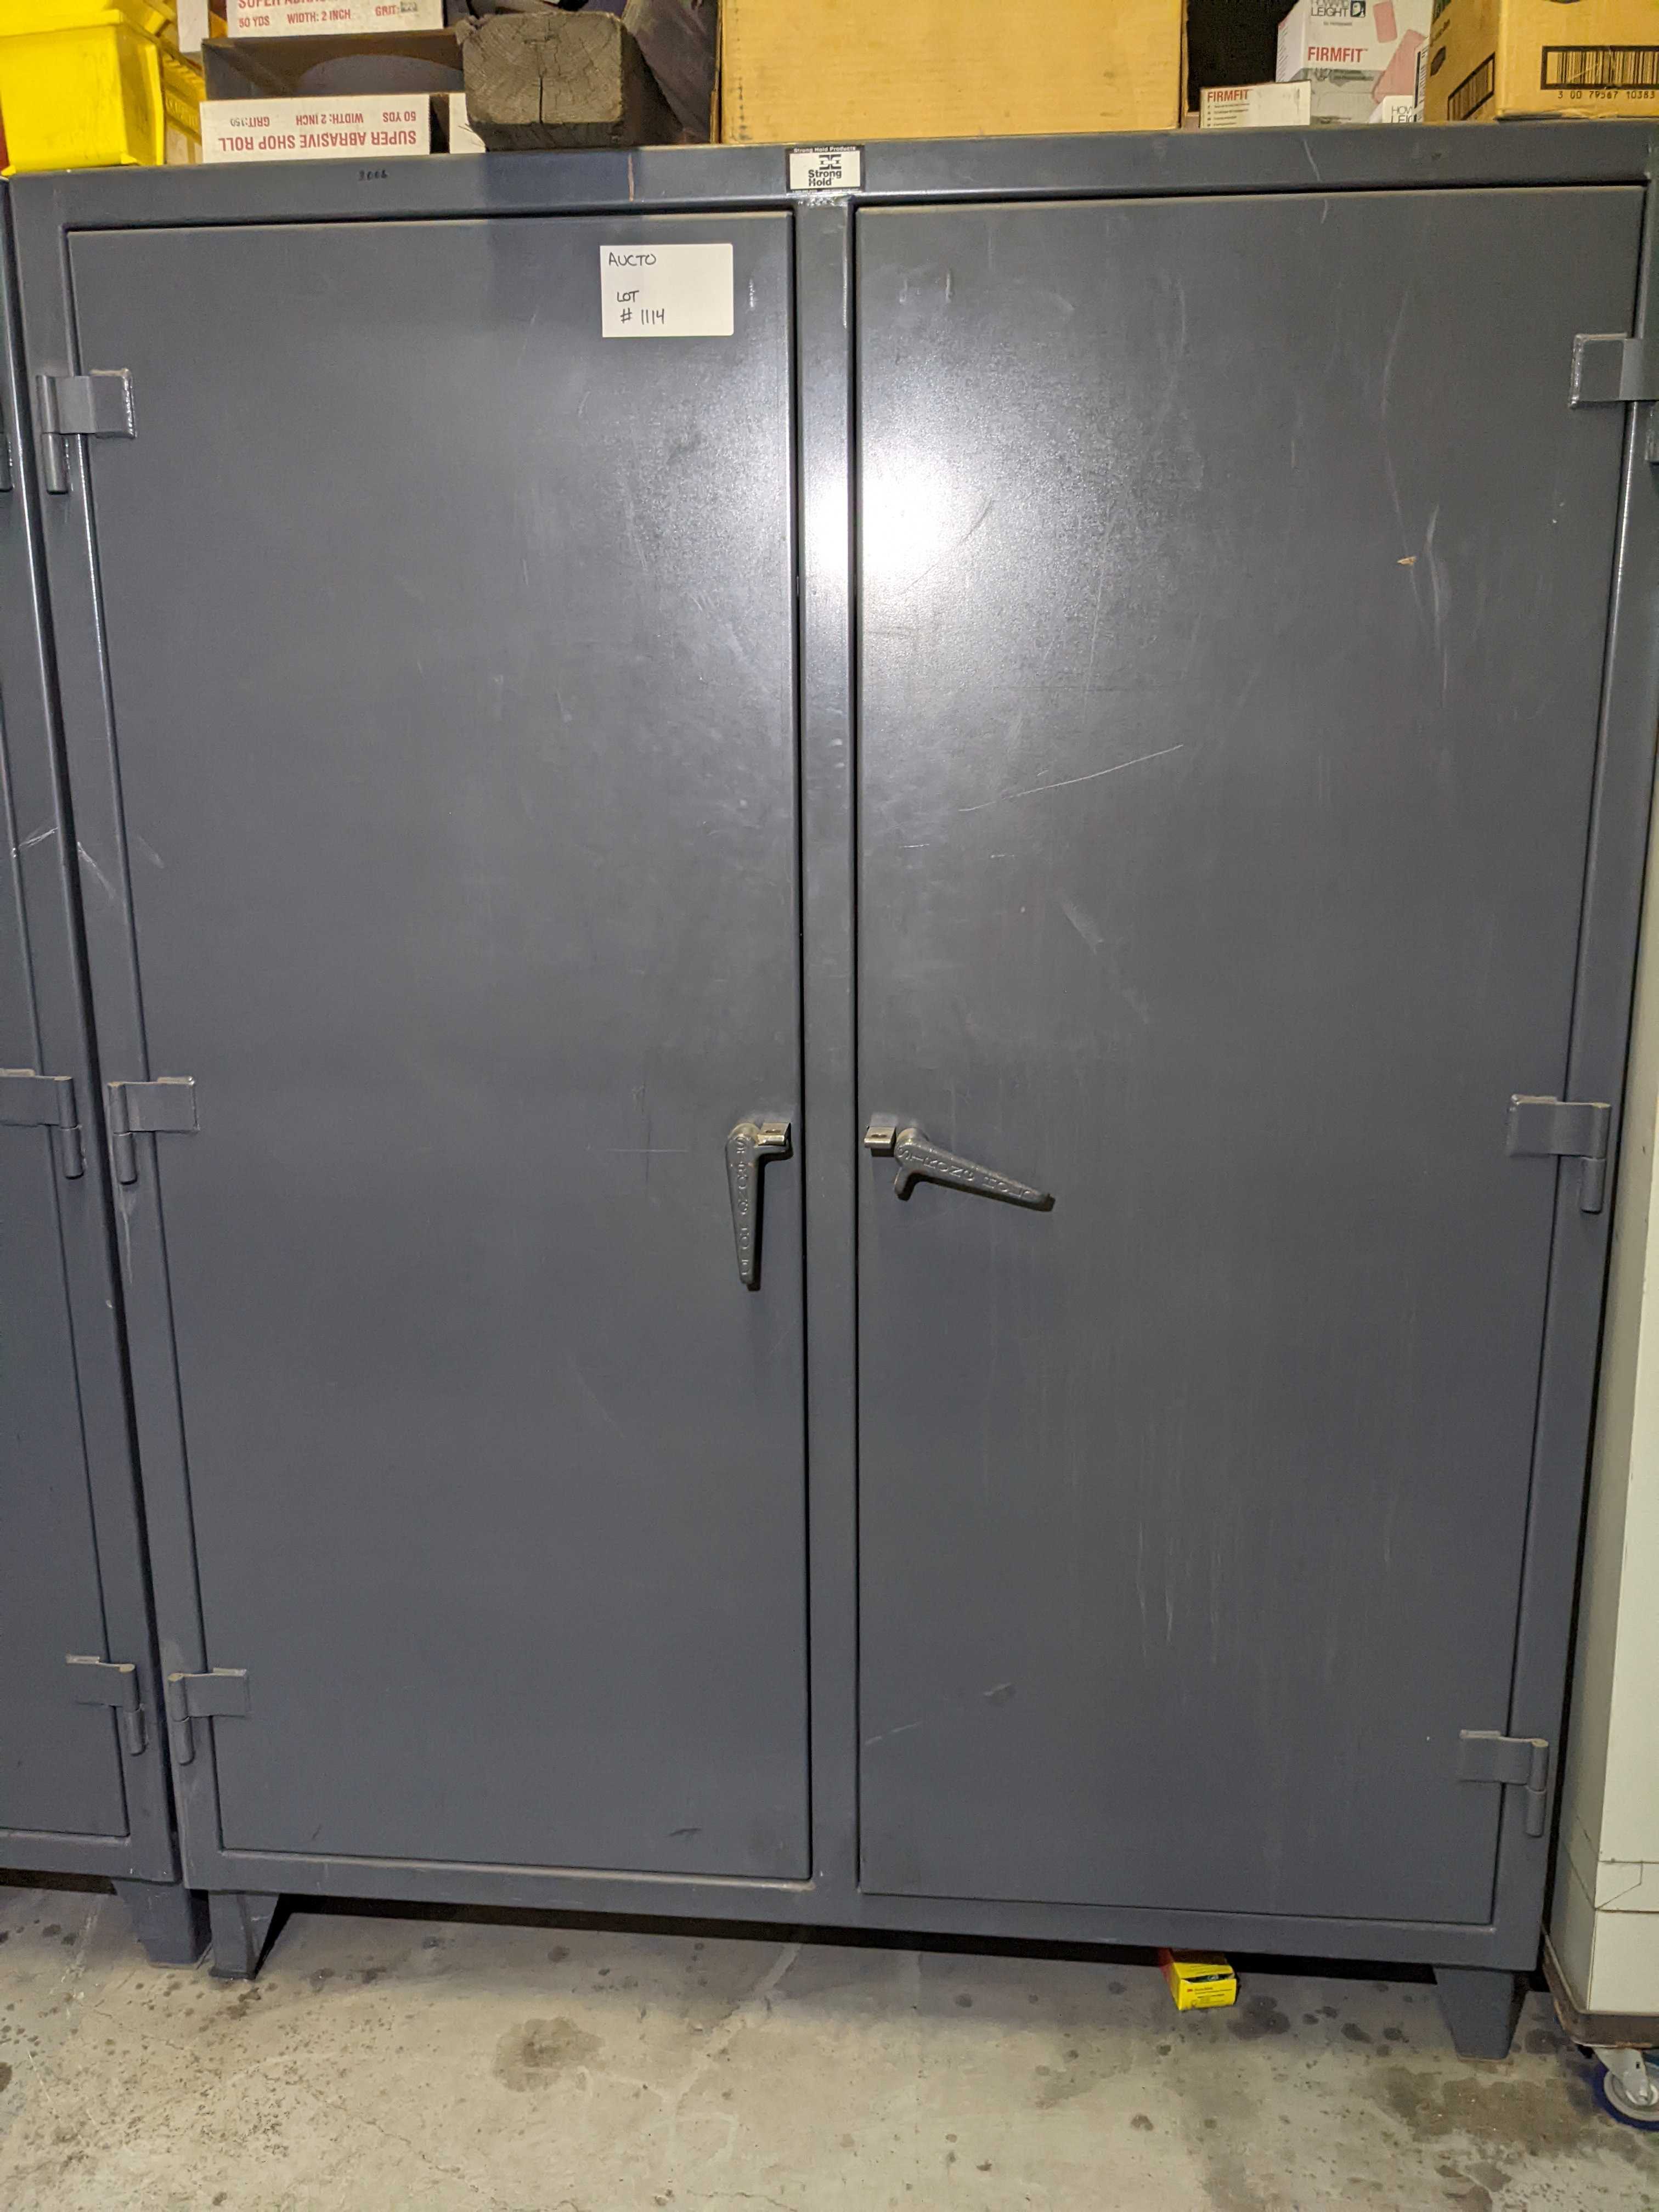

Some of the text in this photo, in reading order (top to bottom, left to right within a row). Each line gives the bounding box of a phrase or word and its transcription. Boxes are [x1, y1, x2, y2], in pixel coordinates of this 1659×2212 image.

[253, 16, 270, 26] YDS
[287, 12, 319, 24] WIDTH:
[321, 10, 327, 21] 2
[329, 9, 351, 21] INCH
[1311, 7, 1348, 17] LEIGHT
[1308, 47, 1363, 63] FIRMFIT
[1207, 89, 1249, 103] FIRMFIT
[1558, 91, 1563, 99] 3
[296, 115, 318, 126] INCH
[321, 114, 327, 124] 2
[330, 113, 364, 124] WIDTH:
[383, 112, 402, 122] YDS
[404, 111, 416, 121] 50
[218, 131, 416, 151] SUPER ABRASIVE SHOP ROLL
[808, 170, 842, 178] Strong
[809, 178, 832, 187] Hold
[609, 252, 656, 266] AUCTO
[617, 290, 639, 302] LOT
[620, 307, 664, 325] # 1114
